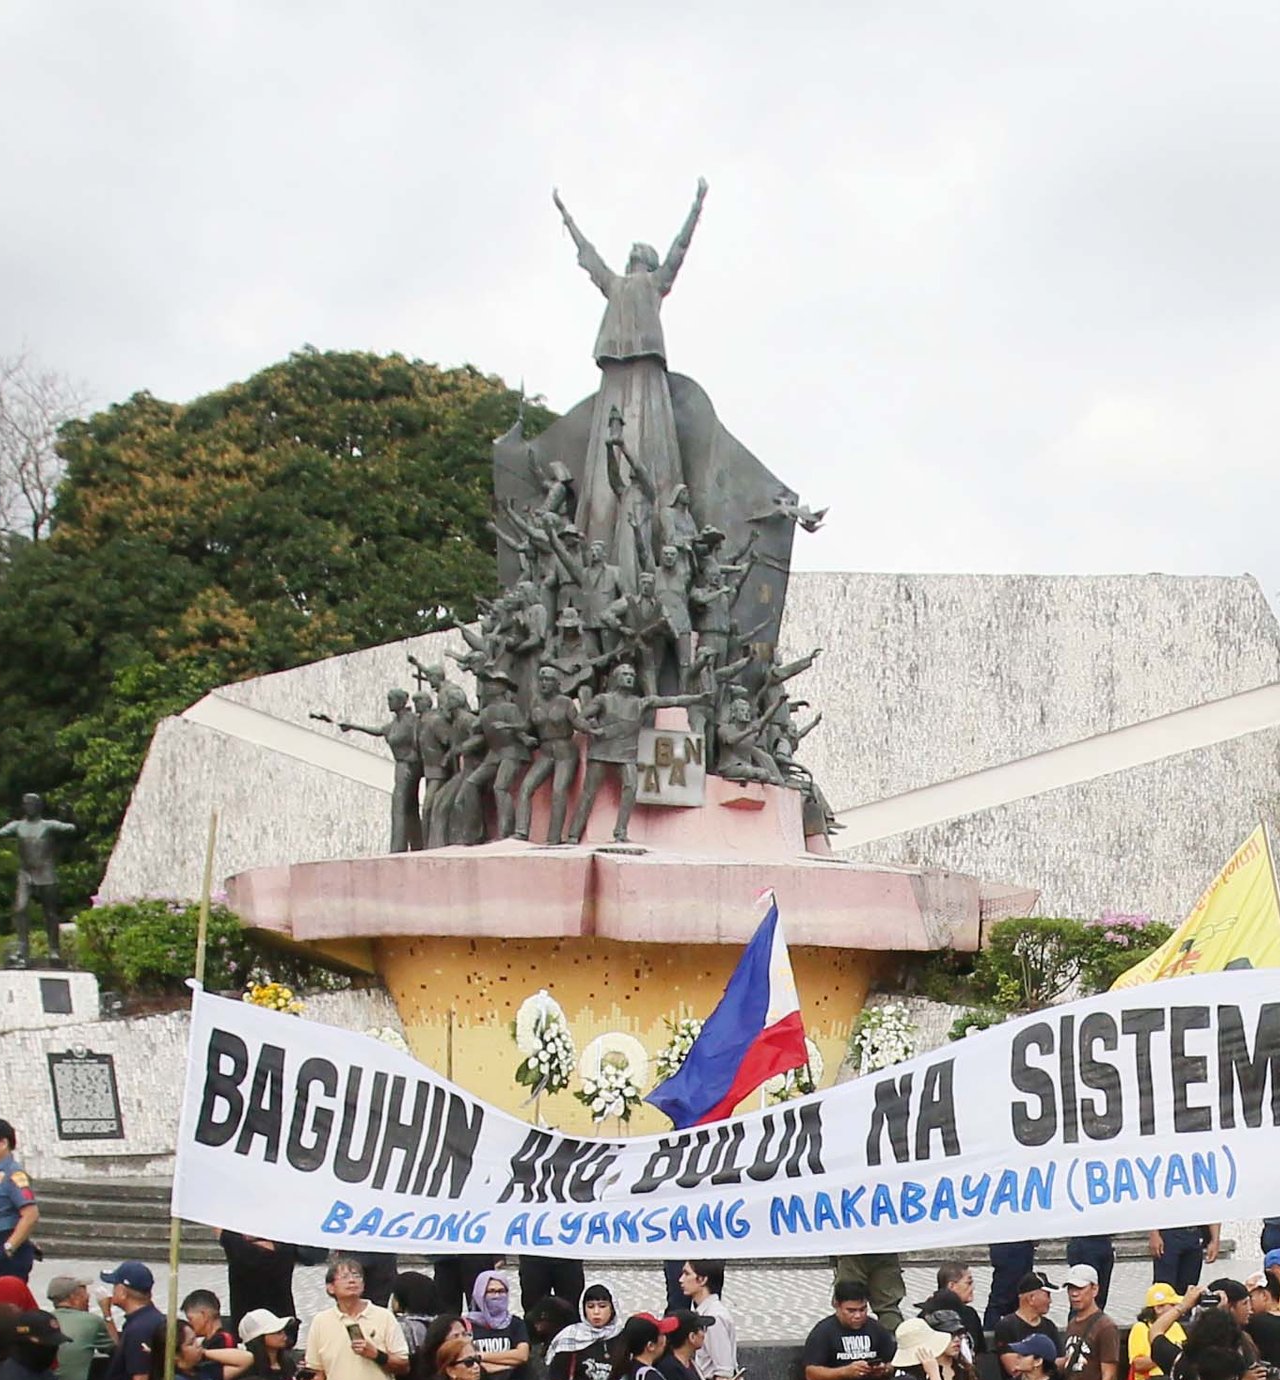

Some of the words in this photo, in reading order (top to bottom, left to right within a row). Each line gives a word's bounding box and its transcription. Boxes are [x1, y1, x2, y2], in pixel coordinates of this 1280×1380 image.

[195, 1028, 484, 1199] BAGUHIN
[497, 1129, 623, 1204] ANG
[867, 1058, 960, 1167] NA
[321, 1200, 491, 1244] BAGONG
[504, 1199, 751, 1246] ALYANSANG
[771, 1161, 1056, 1237] MAKABAYAN
[1066, 1145, 1237, 1212] (BAYAN)
